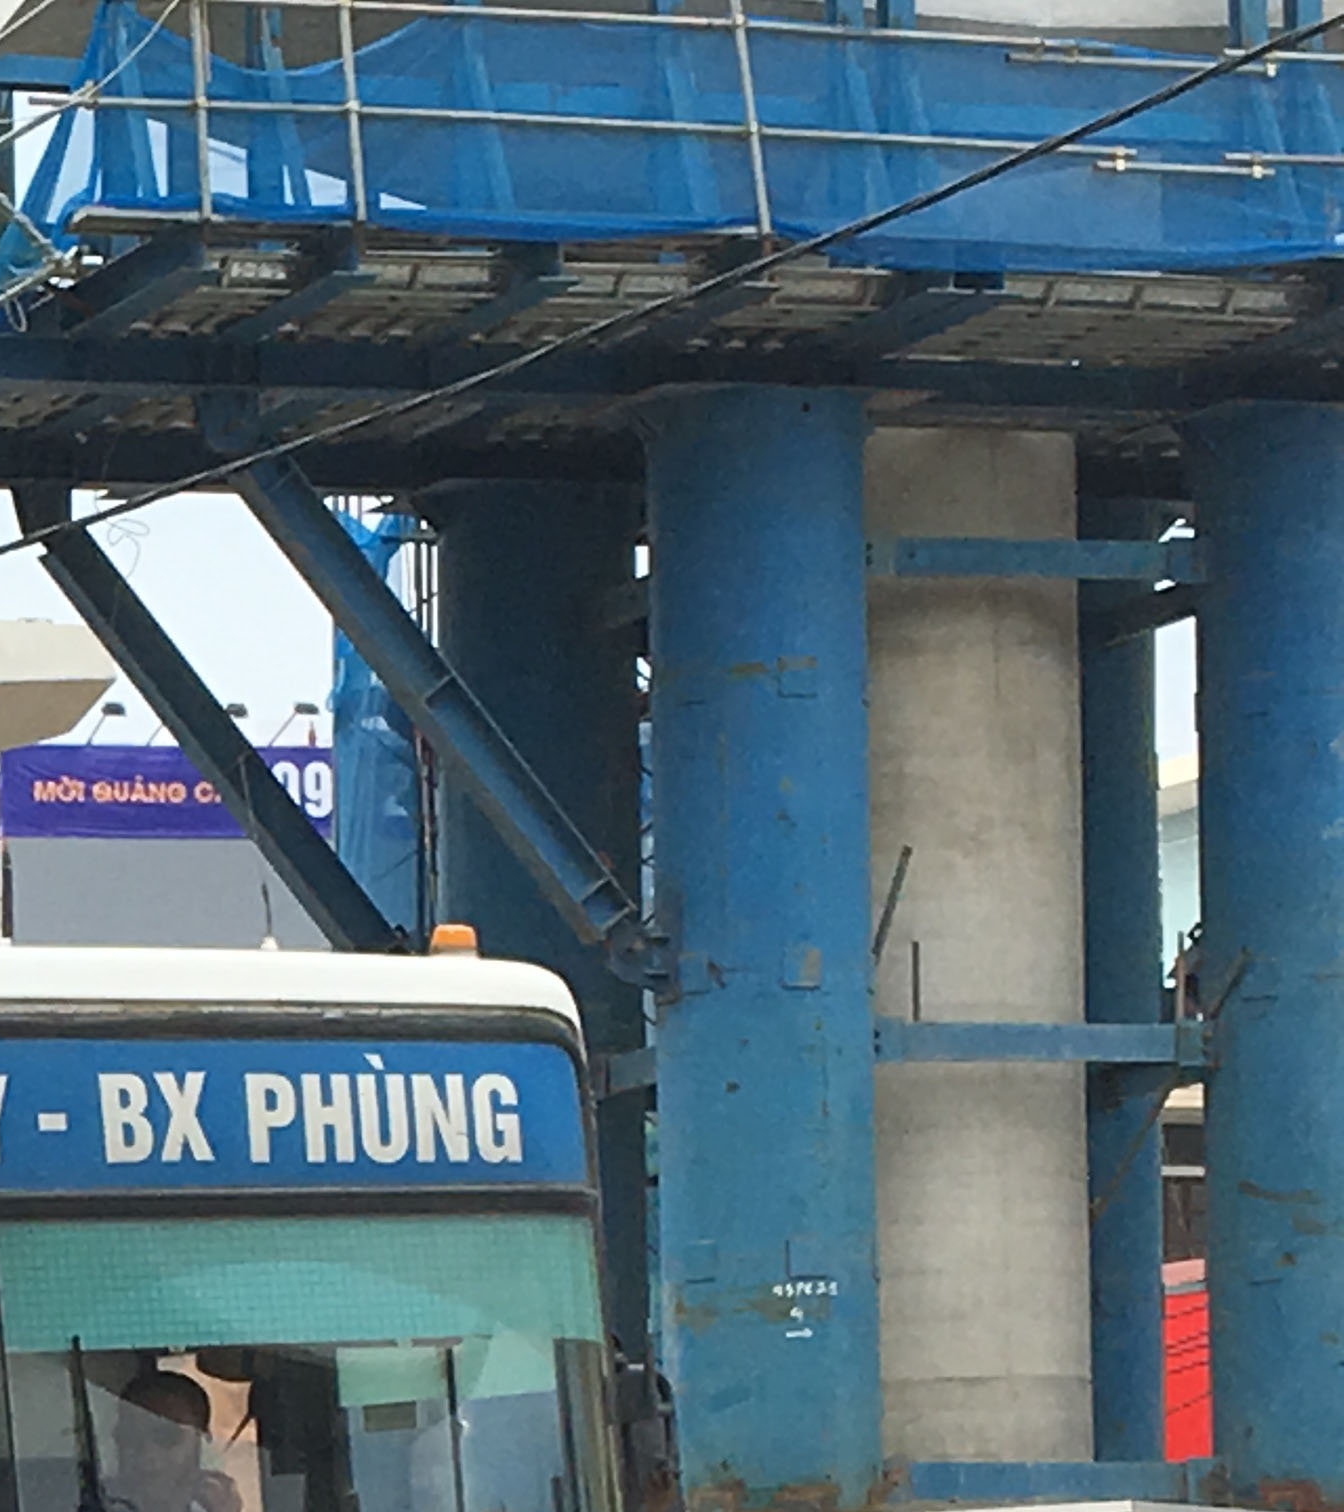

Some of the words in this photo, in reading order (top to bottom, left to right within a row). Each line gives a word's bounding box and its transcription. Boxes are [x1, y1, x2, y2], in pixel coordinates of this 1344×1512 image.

[91, 775, 186, 804] QUẢNG
[98, 1071, 215, 1164] BX
[244, 1053, 523, 1164] PHÙNG
